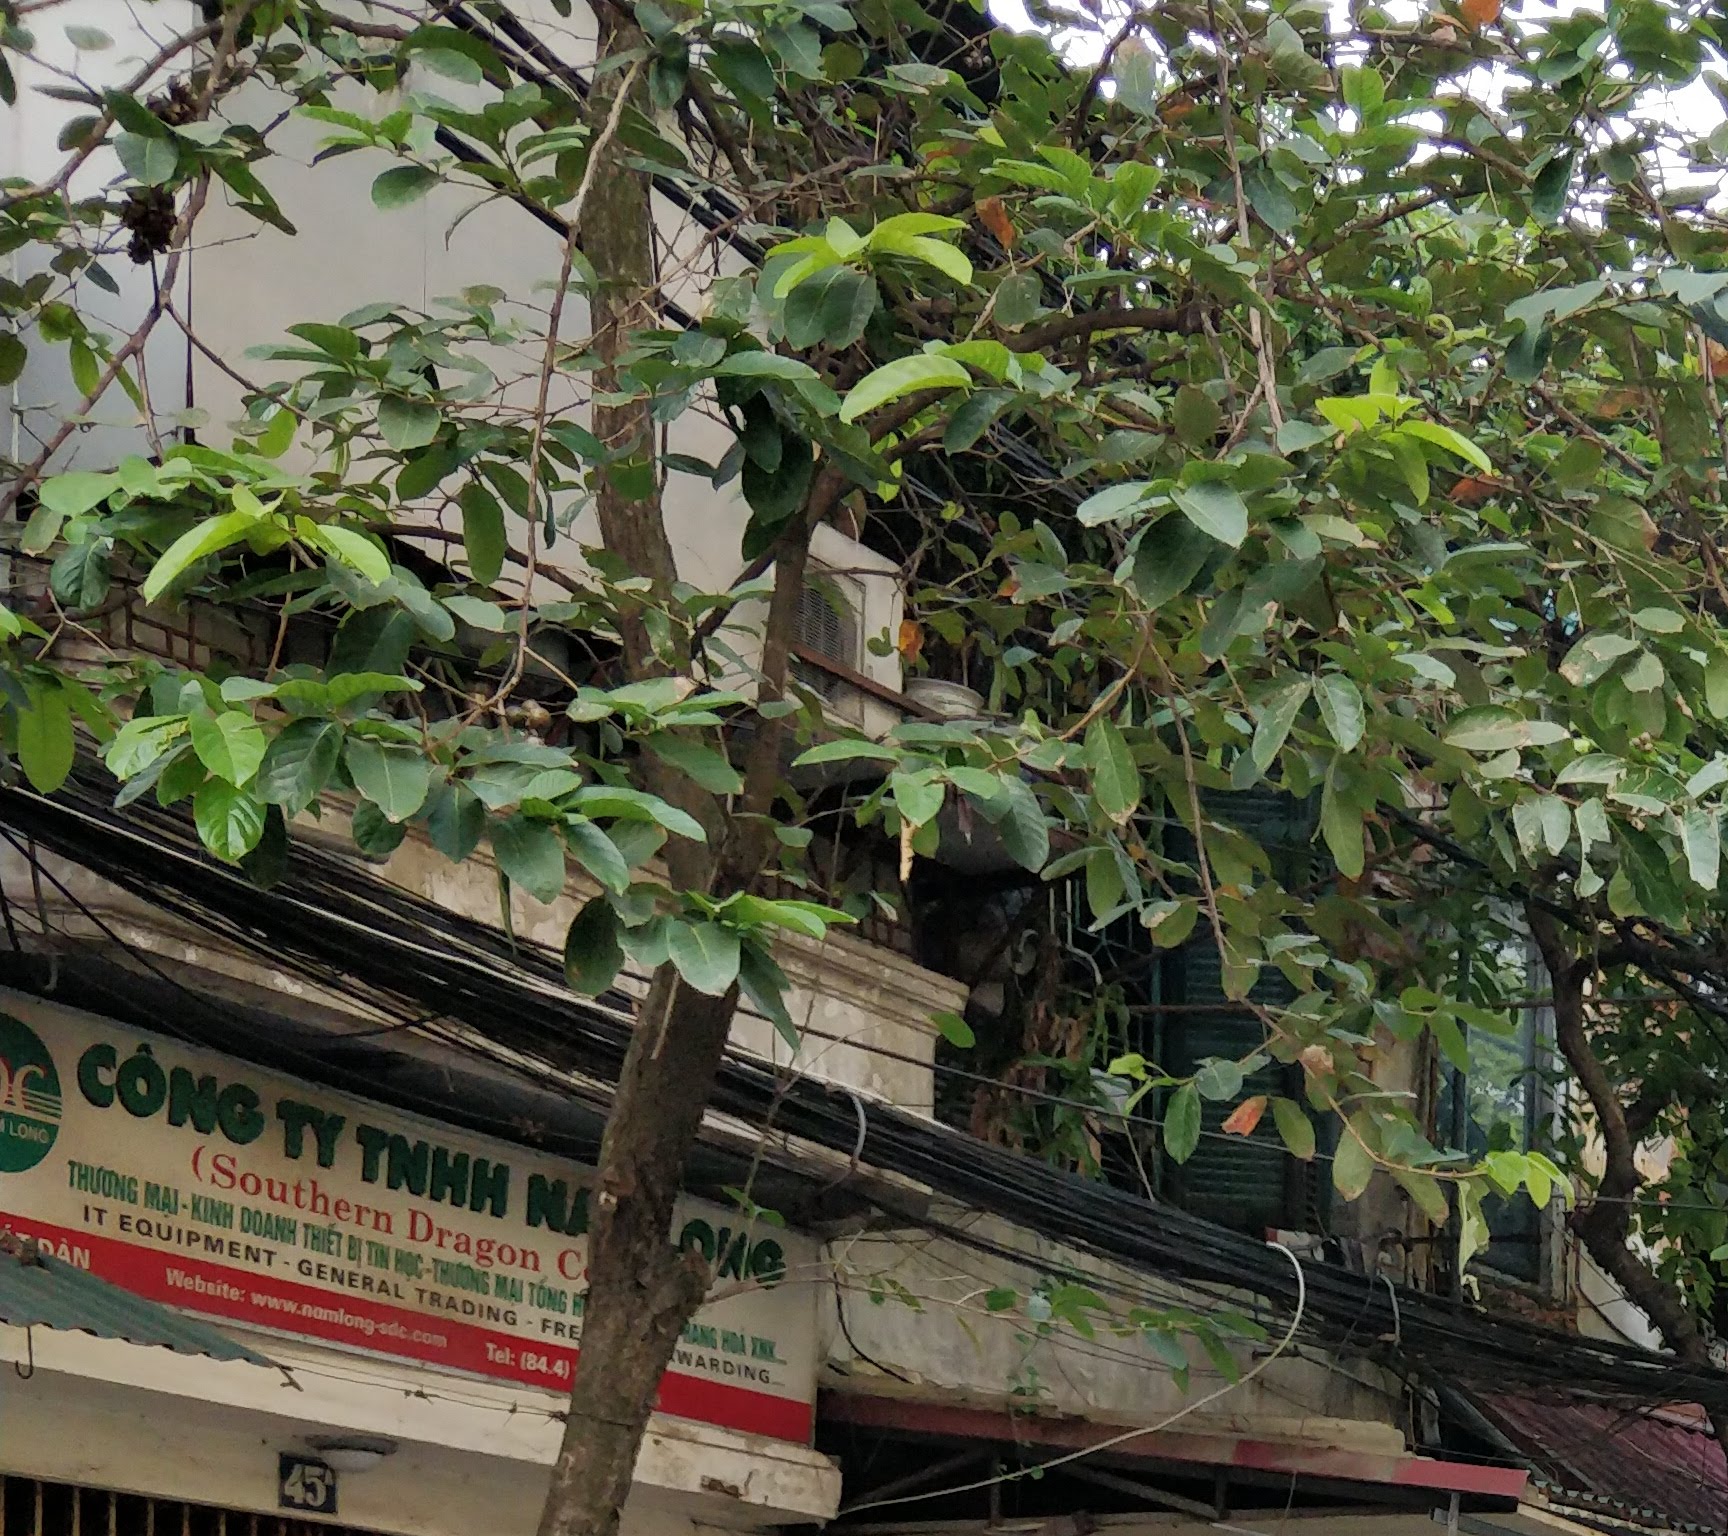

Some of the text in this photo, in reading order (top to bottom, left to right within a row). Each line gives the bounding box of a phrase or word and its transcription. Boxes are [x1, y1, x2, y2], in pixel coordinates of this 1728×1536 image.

[77, 1043, 265, 1145] CÔNG
[276, 1099, 346, 1169] TY
[356, 1123, 510, 1219] TNHH
[526, 1173, 592, 1236] NA
[83, 1205, 108, 1226] IT
[119, 1214, 278, 1267] EQUIPMENT
[298, 1258, 405, 1301] GENERAL
[415, 1288, 518, 1326] TRADING
[240, 1207, 297, 1246] DOANH
[303, 1222, 342, 1257] THIẾT
[347, 1234, 361, 1268] BỊ
[366, 1240, 390, 1269] TIN
[495, 1272, 523, 1307] MẠI
[528, 1275, 567, 1313] TỔNG
[406, 1208, 541, 1273] Dragon
[557, 1249, 591, 1284] C
[166, 1268, 571, 1379] Website: www.namlong-sdc.com Tel: (84.4)
